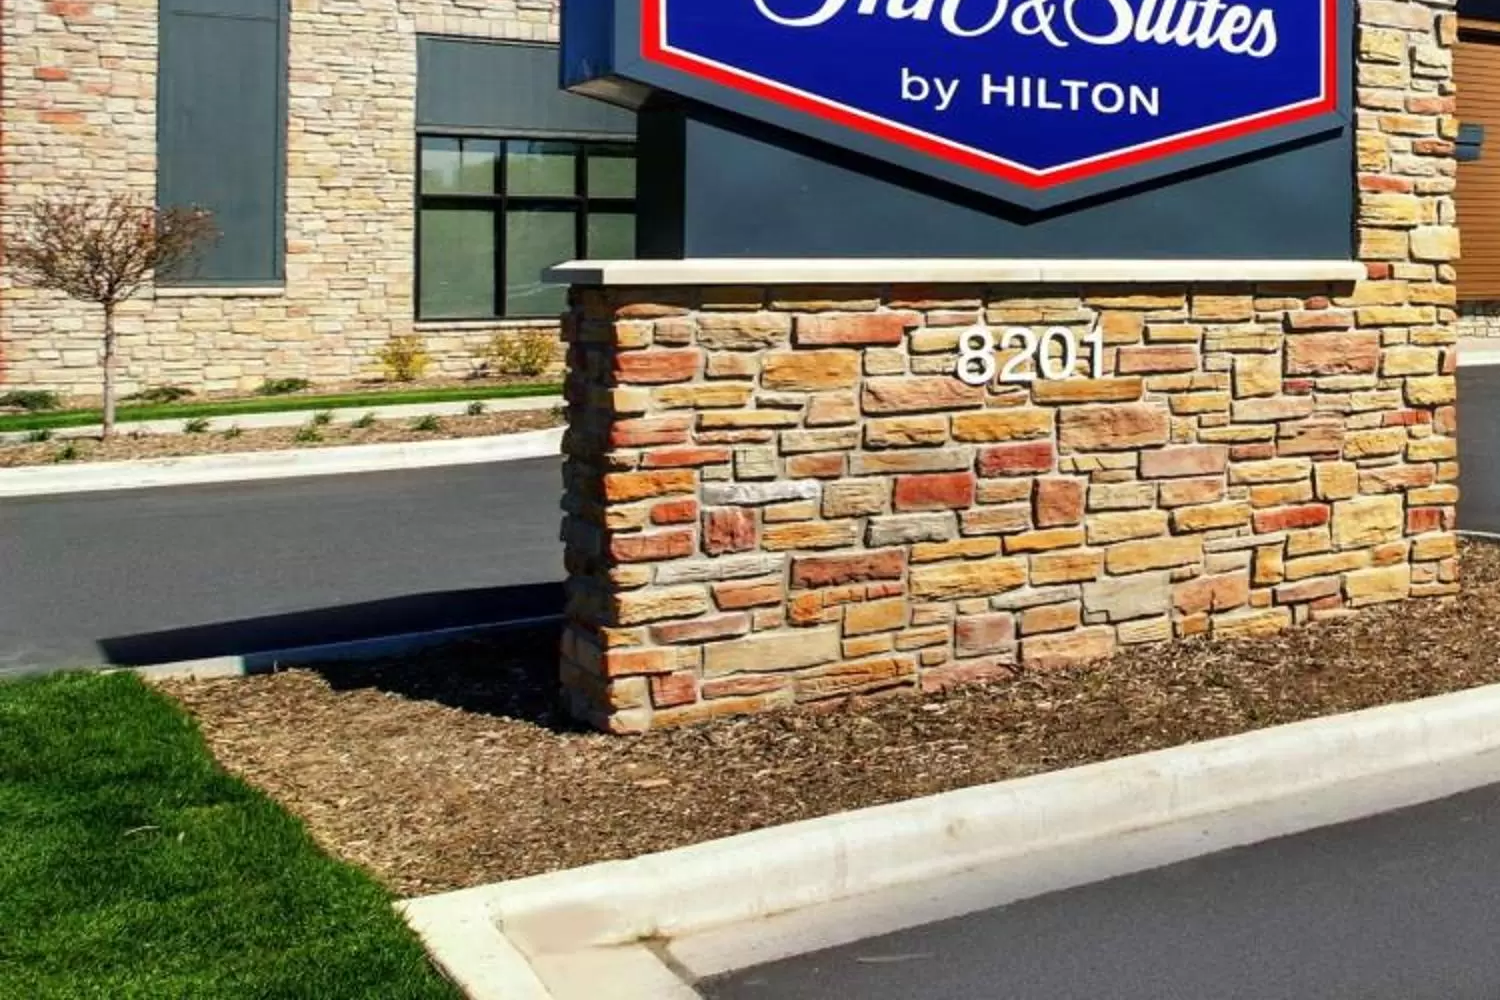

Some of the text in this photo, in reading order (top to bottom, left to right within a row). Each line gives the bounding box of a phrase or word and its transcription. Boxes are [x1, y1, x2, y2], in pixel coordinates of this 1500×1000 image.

[901, 67, 1159, 116] by HILTON
[957, 325, 1104, 385] 8201
